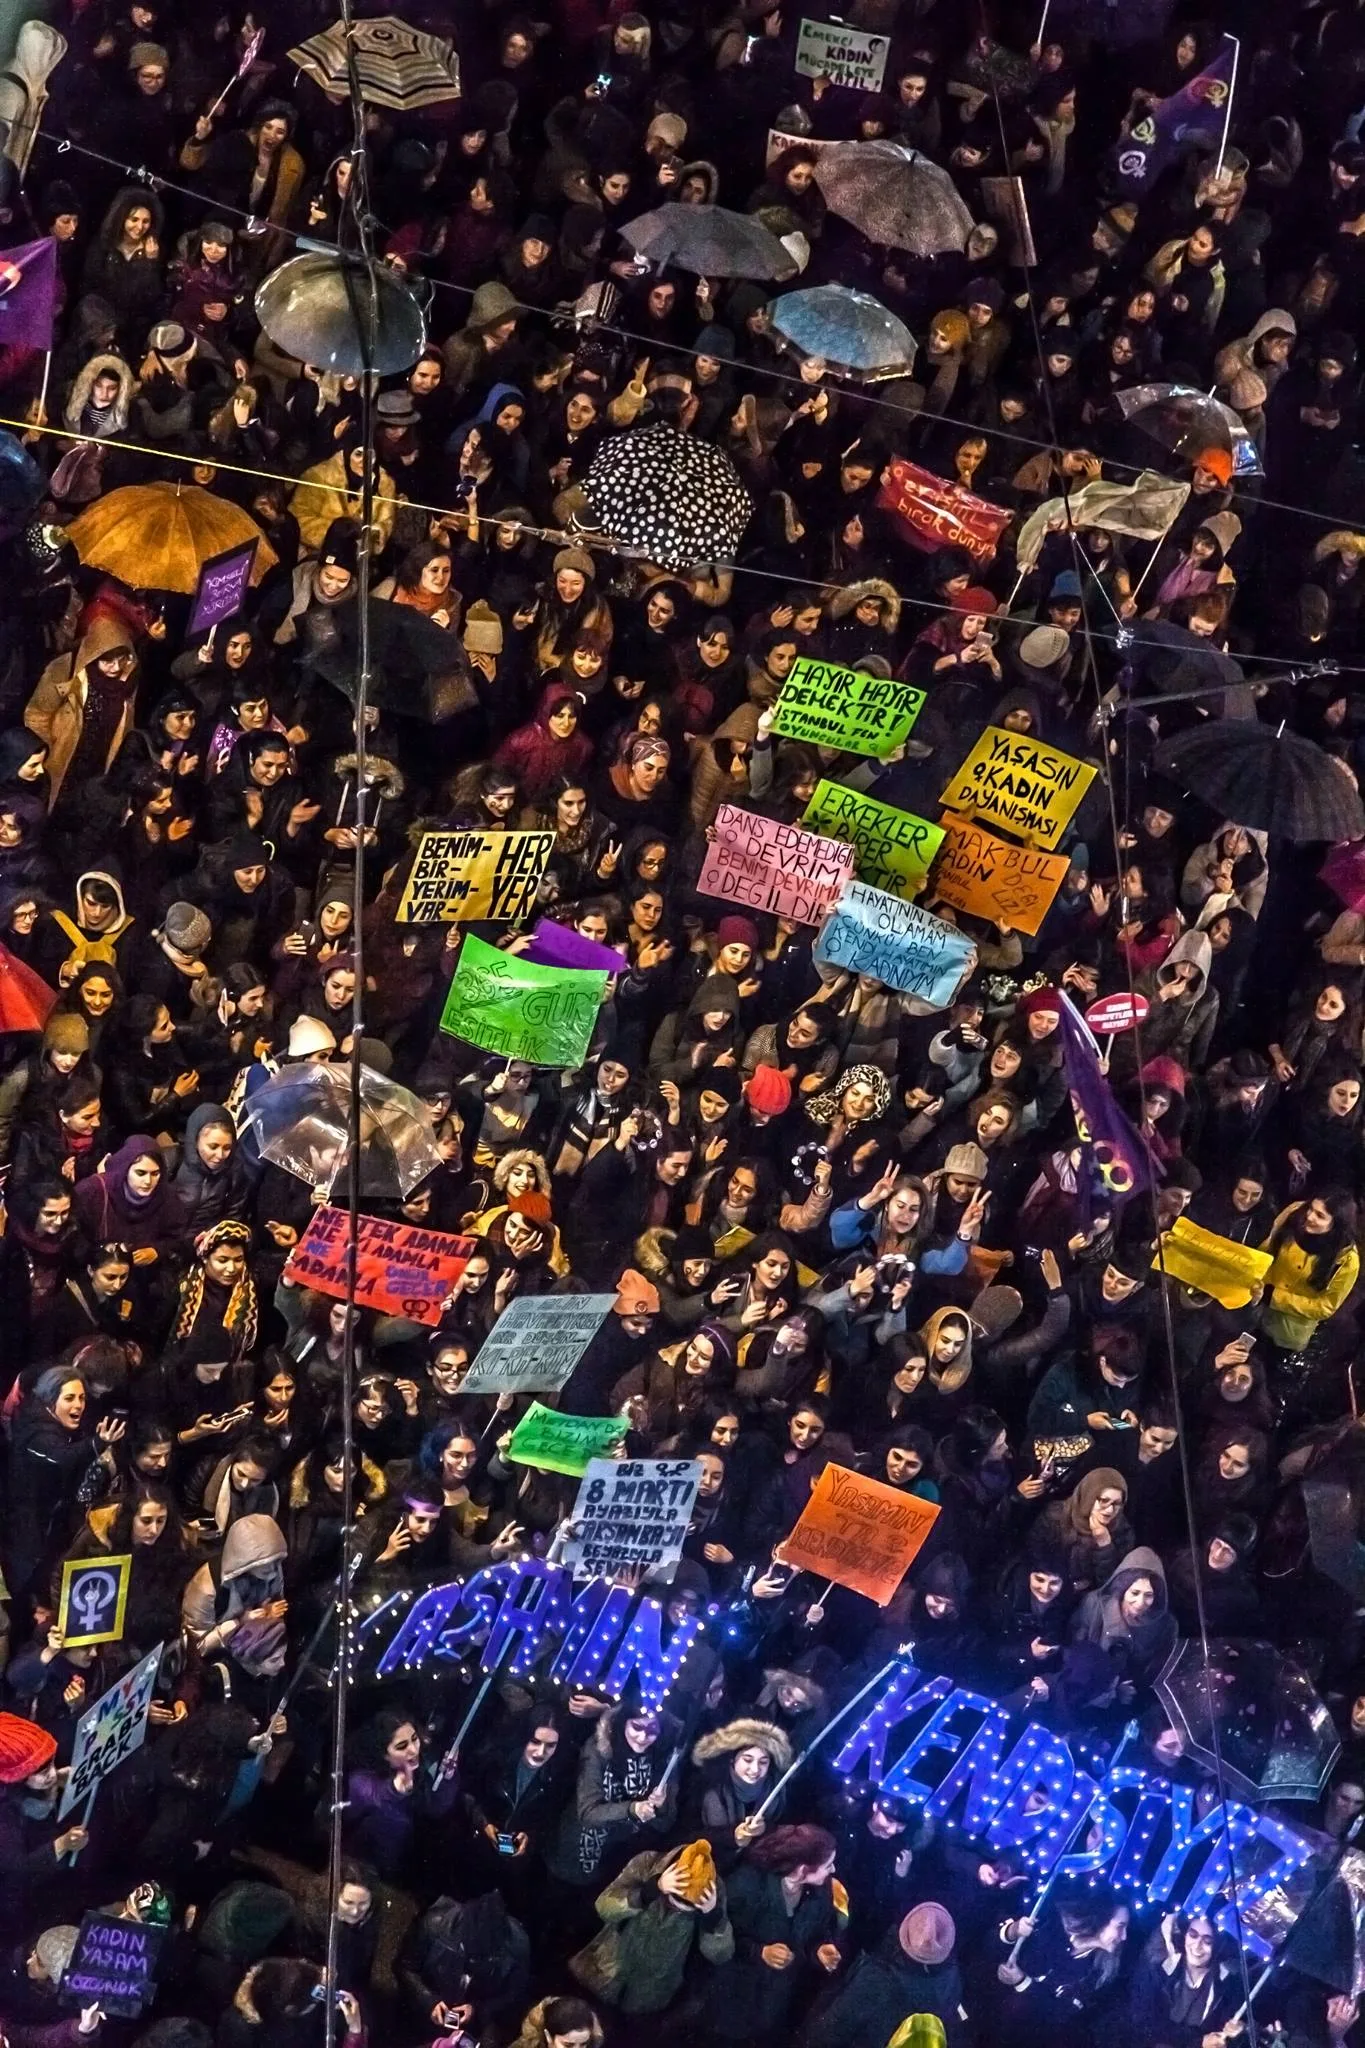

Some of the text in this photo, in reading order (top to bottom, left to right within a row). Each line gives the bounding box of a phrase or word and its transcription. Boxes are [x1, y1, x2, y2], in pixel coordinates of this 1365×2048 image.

[826, 46, 873, 65] KADIN
[791, 662, 920, 715] HAYIR HAYIR
[990, 736, 1081, 791] YAŞASIN
[983, 766, 1055, 810] KADIN
[820, 787, 929, 864] ERKEKLER
[959, 786, 1058, 837] DAYANIŞMASI
[495, 834, 553, 875] HER
[942, 849, 995, 882] ADIN
[948, 826, 1056, 882] MAKBUL
[487, 875, 539, 918] YER
[852, 886, 924, 924] HAYATININ
[878, 913, 946, 949] OLAMAM
[906, 942, 941, 961] BEN
[522, 983, 599, 1030] GÜN
[309, 1223, 341, 1243] NE
[372, 1243, 440, 1271] ADAMLA
[317, 1209, 345, 1227] NE
[357, 1219, 401, 1243] TEK
[586, 1479, 695, 1507] 8 MARTI
[98, 1673, 137, 1722] MY
[72, 1703, 146, 1785] GRABS
[73, 1732, 132, 1800] BACK
[87, 1925, 146, 1952] KADIN
